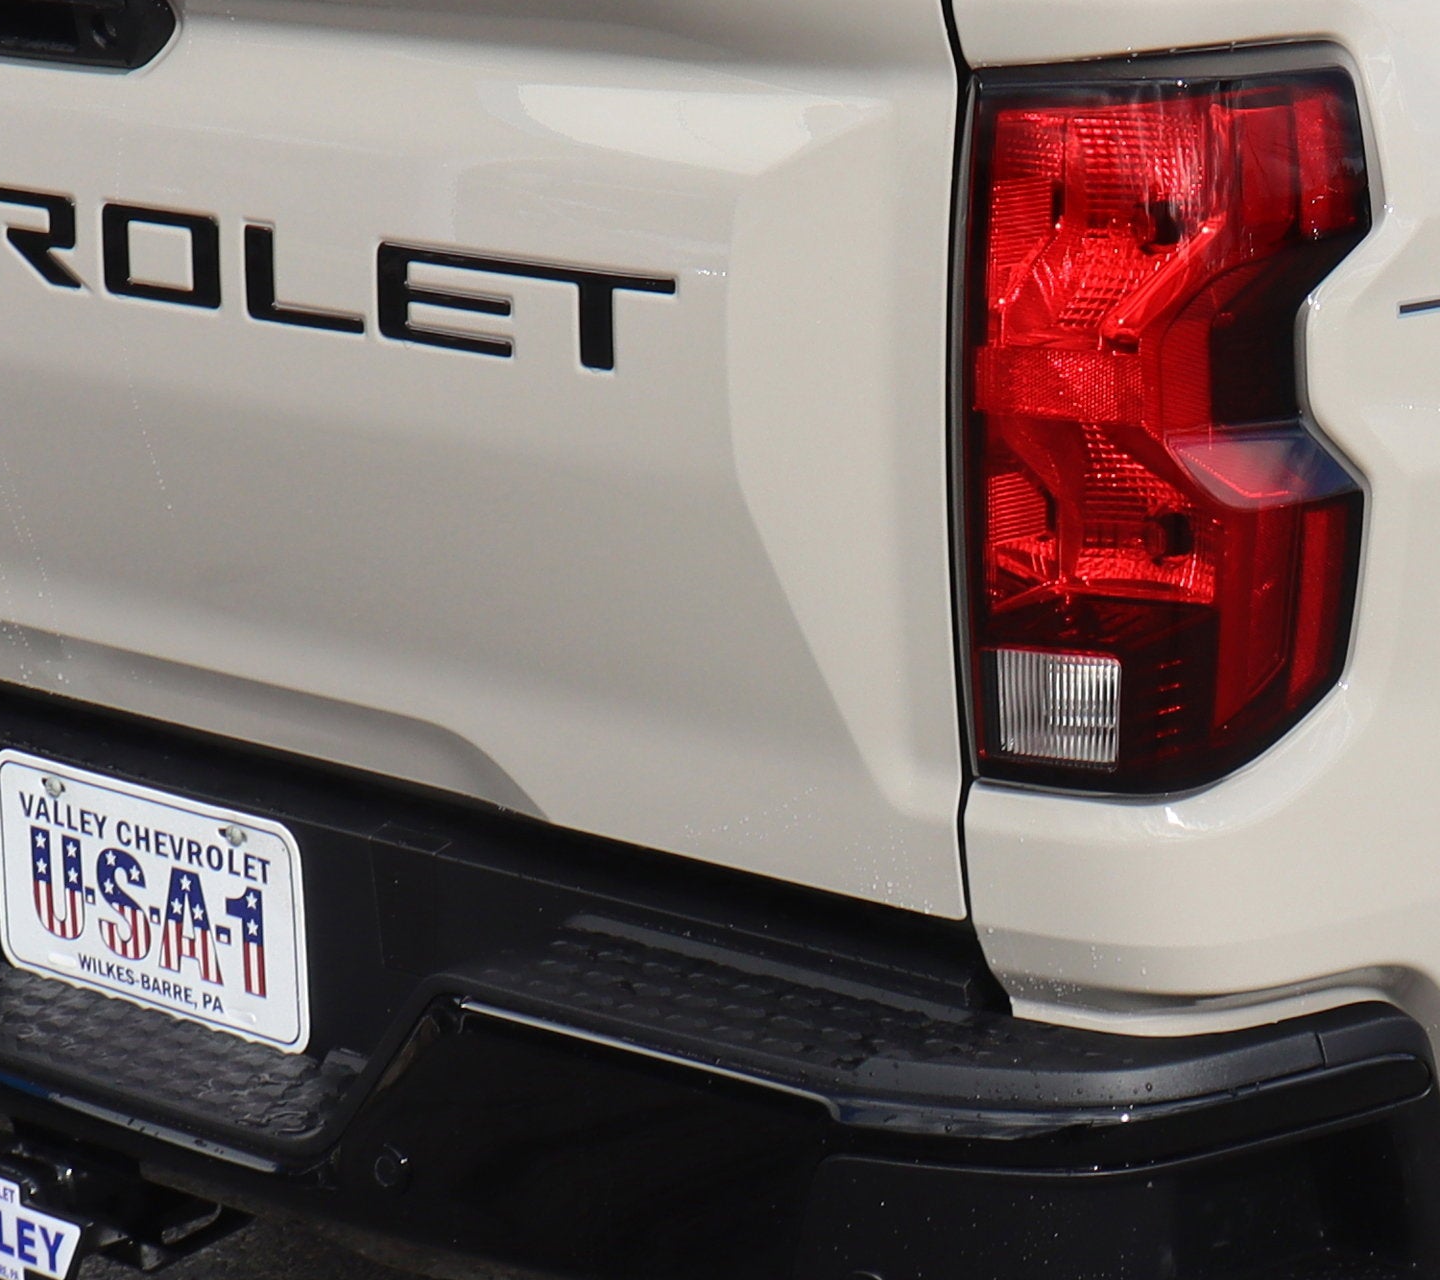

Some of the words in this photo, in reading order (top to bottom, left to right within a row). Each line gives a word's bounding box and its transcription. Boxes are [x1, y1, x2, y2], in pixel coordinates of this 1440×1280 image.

[19, 790, 109, 840] VALLEY
[116, 819, 271, 886] CHEVROLET
[77, 951, 200, 1011] WILKES-BARRE,
[202, 991, 225, 1014] PA
